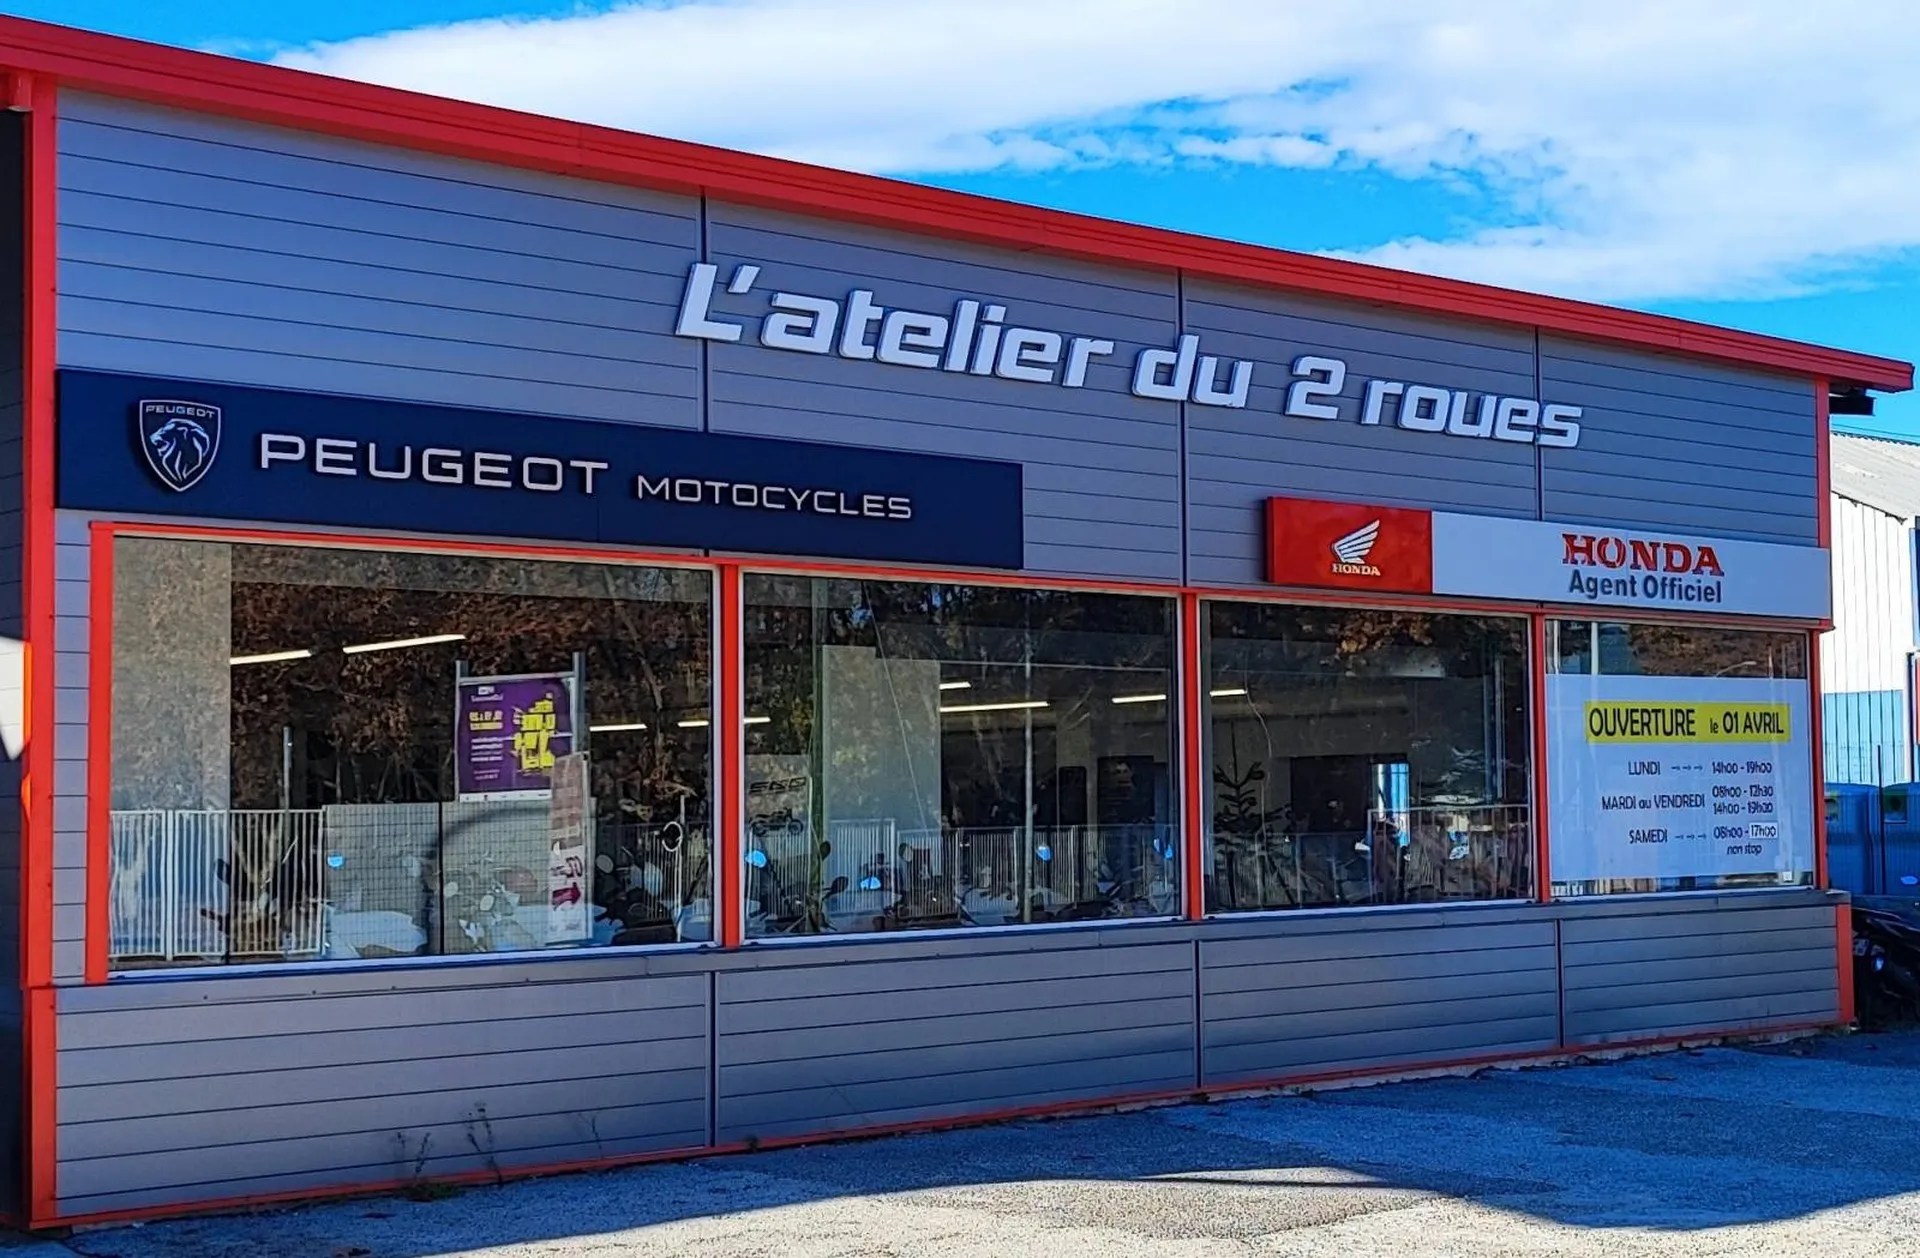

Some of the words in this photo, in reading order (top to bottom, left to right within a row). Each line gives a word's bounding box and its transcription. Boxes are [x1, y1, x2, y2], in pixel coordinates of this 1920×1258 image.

[675, 262, 1115, 388] L'atelier
[1132, 334, 1254, 409] du
[1284, 355, 1347, 420] 2
[1361, 379, 1583, 448] roues
[145, 405, 216, 419] PEUGEOT
[260, 433, 609, 494] PEUGEOT
[637, 475, 912, 519] MOTOCYCLES
[1562, 533, 1725, 577] HONDA
[1331, 562, 1381, 577] HONDA
[1569, 569, 1637, 599] Agent
[1643, 575, 1722, 603] Officiel
[1588, 707, 1696, 737] OUVERTURE
[1710, 718, 1719, 734] le
[1722, 711, 1739, 733] 01
[1743, 711, 1785, 735] AVRIL
[1628, 761, 1661, 775] LUNDI
[1712, 761, 1738, 774] 14h00
[1746, 761, 1772, 774] 19h00
[1712, 785, 1741, 798] 08h00
[1749, 784, 1774, 797] 12h30
[1601, 795, 1637, 810] MARDI
[1638, 799, 1652, 809] au
[1653, 794, 1705, 809] VENDREDI
[1713, 803, 1740, 815] 14h00
[1629, 828, 1668, 844] SAMEDI
[1750, 824, 1777, 837] 17h00
[1726, 845, 1743, 855] non
[1744, 842, 1762, 855] stop
